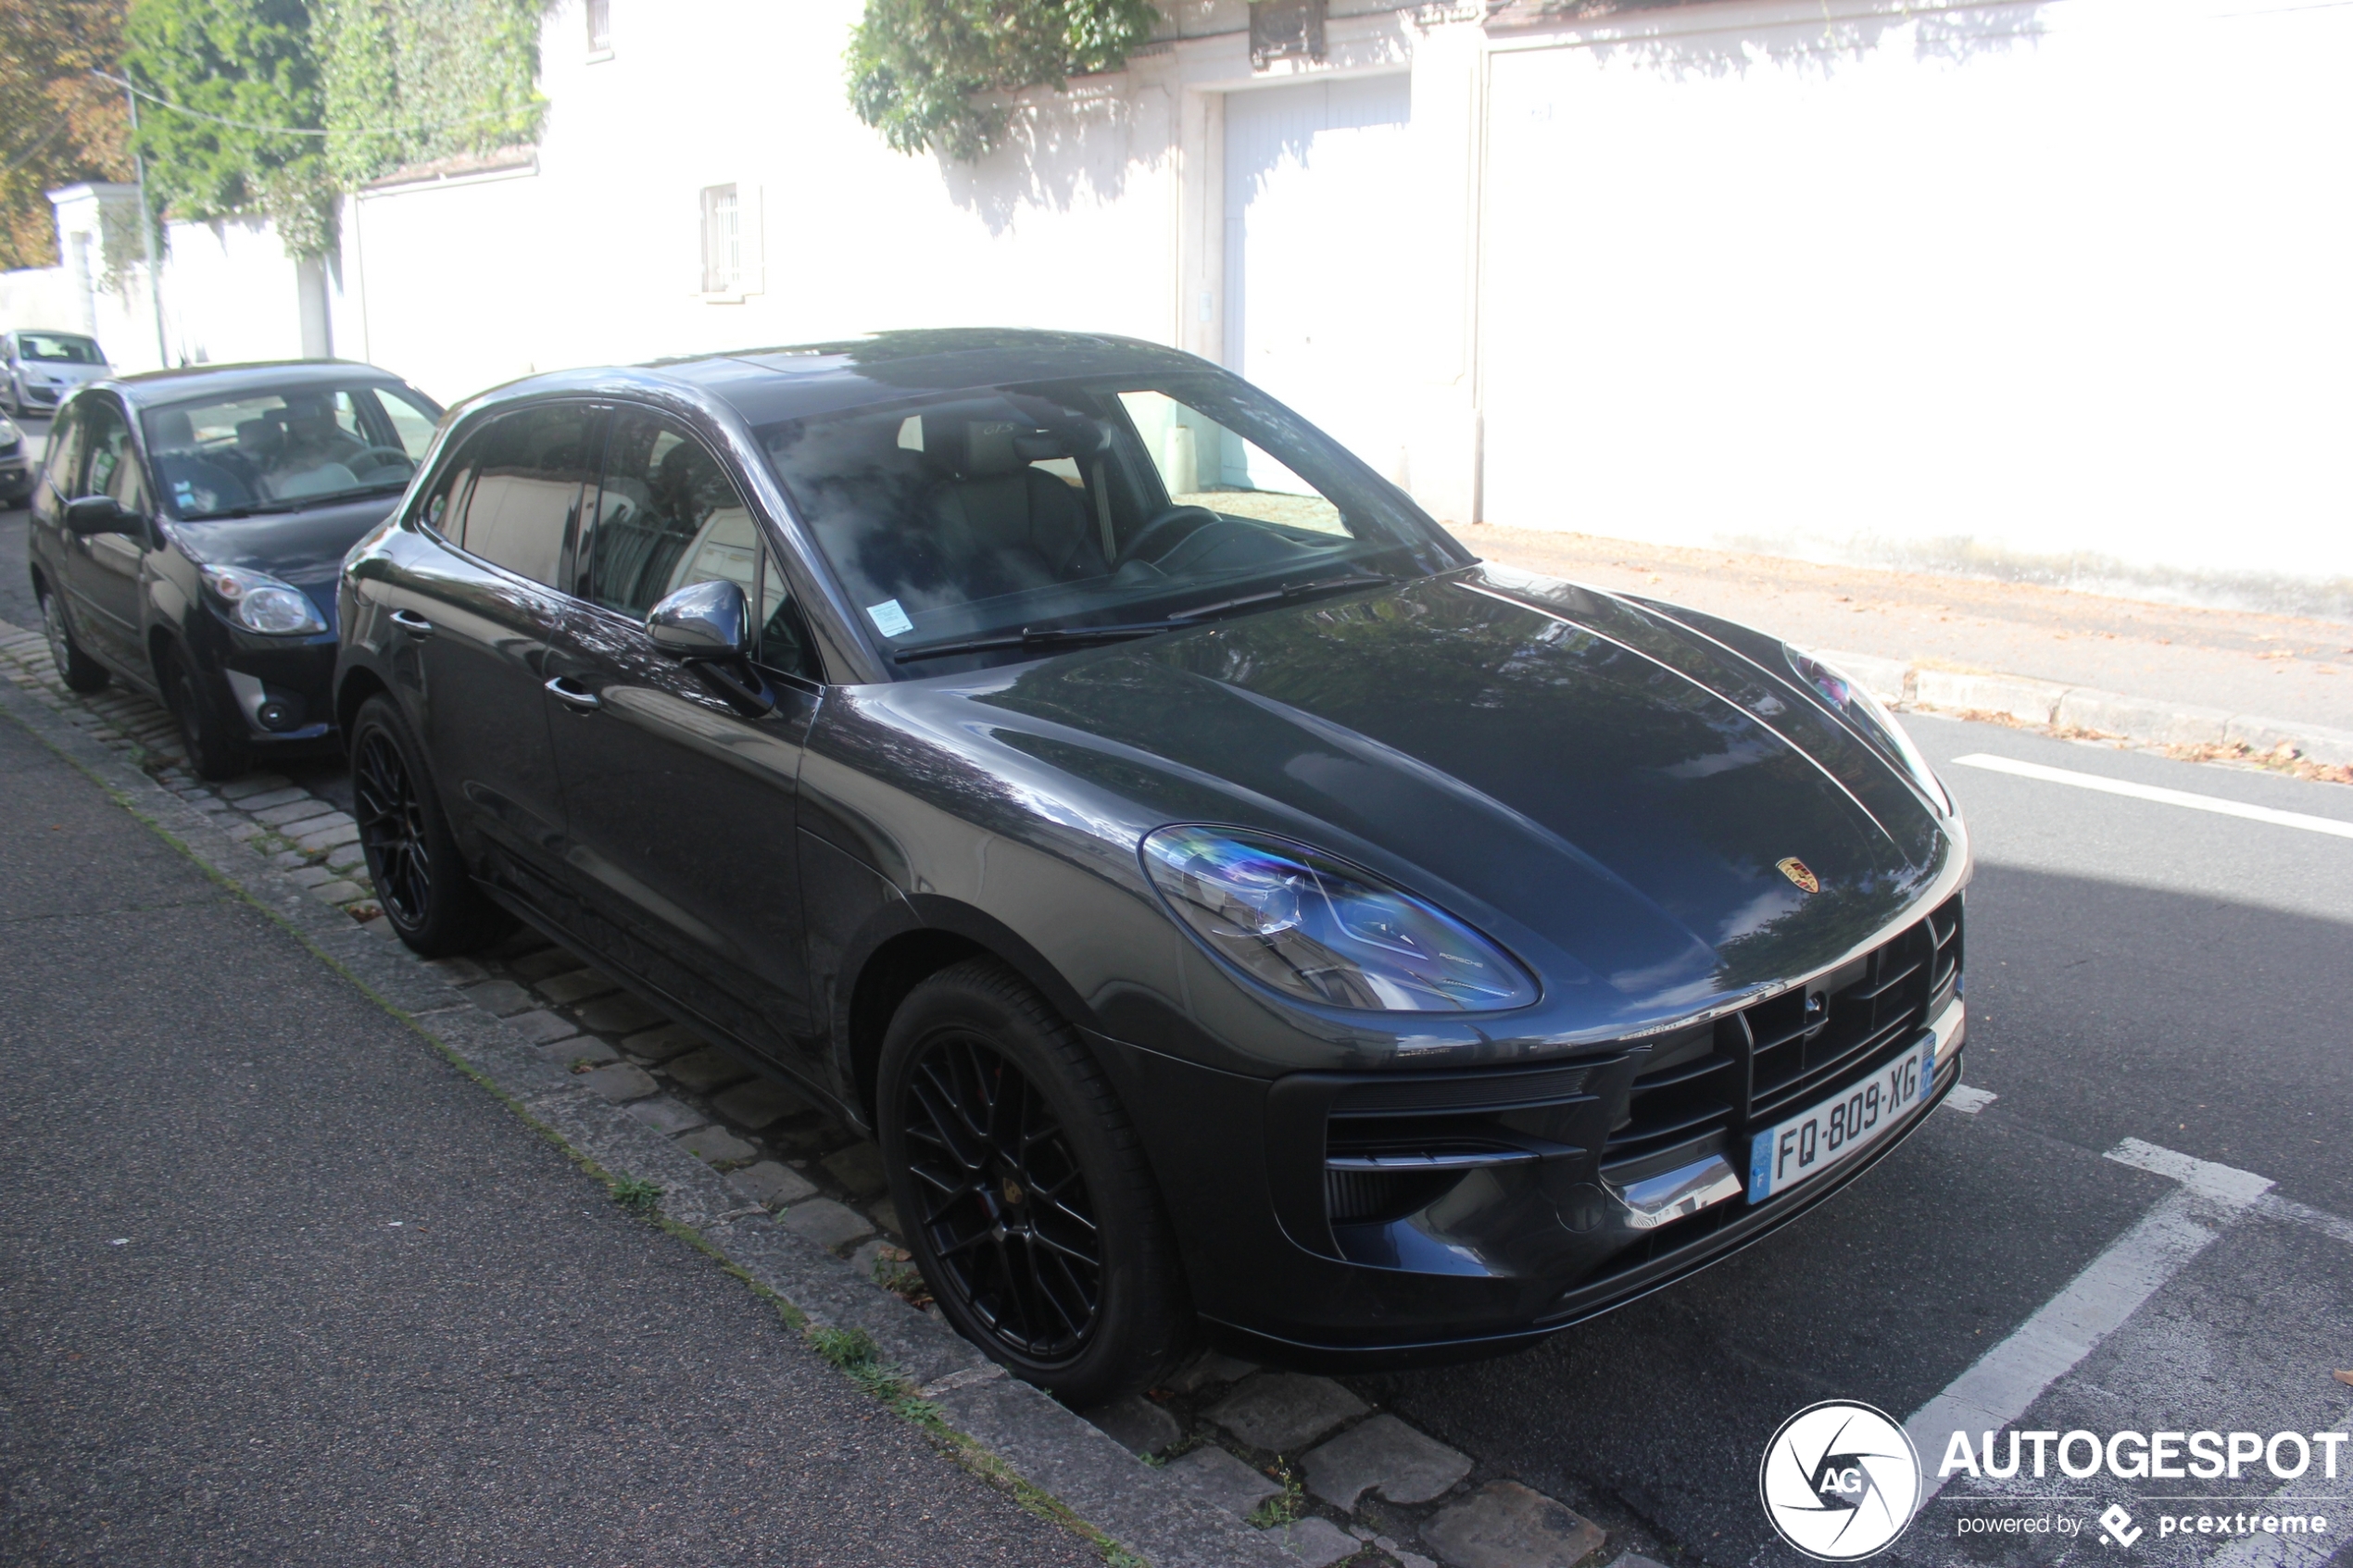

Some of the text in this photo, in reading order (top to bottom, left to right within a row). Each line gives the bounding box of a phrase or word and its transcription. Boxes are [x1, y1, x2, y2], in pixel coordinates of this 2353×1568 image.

[1439, 952, 1484, 969] PORSCHE
[1777, 1055, 1918, 1179] FQ-809-XG
[1756, 1173, 1765, 1188] F
